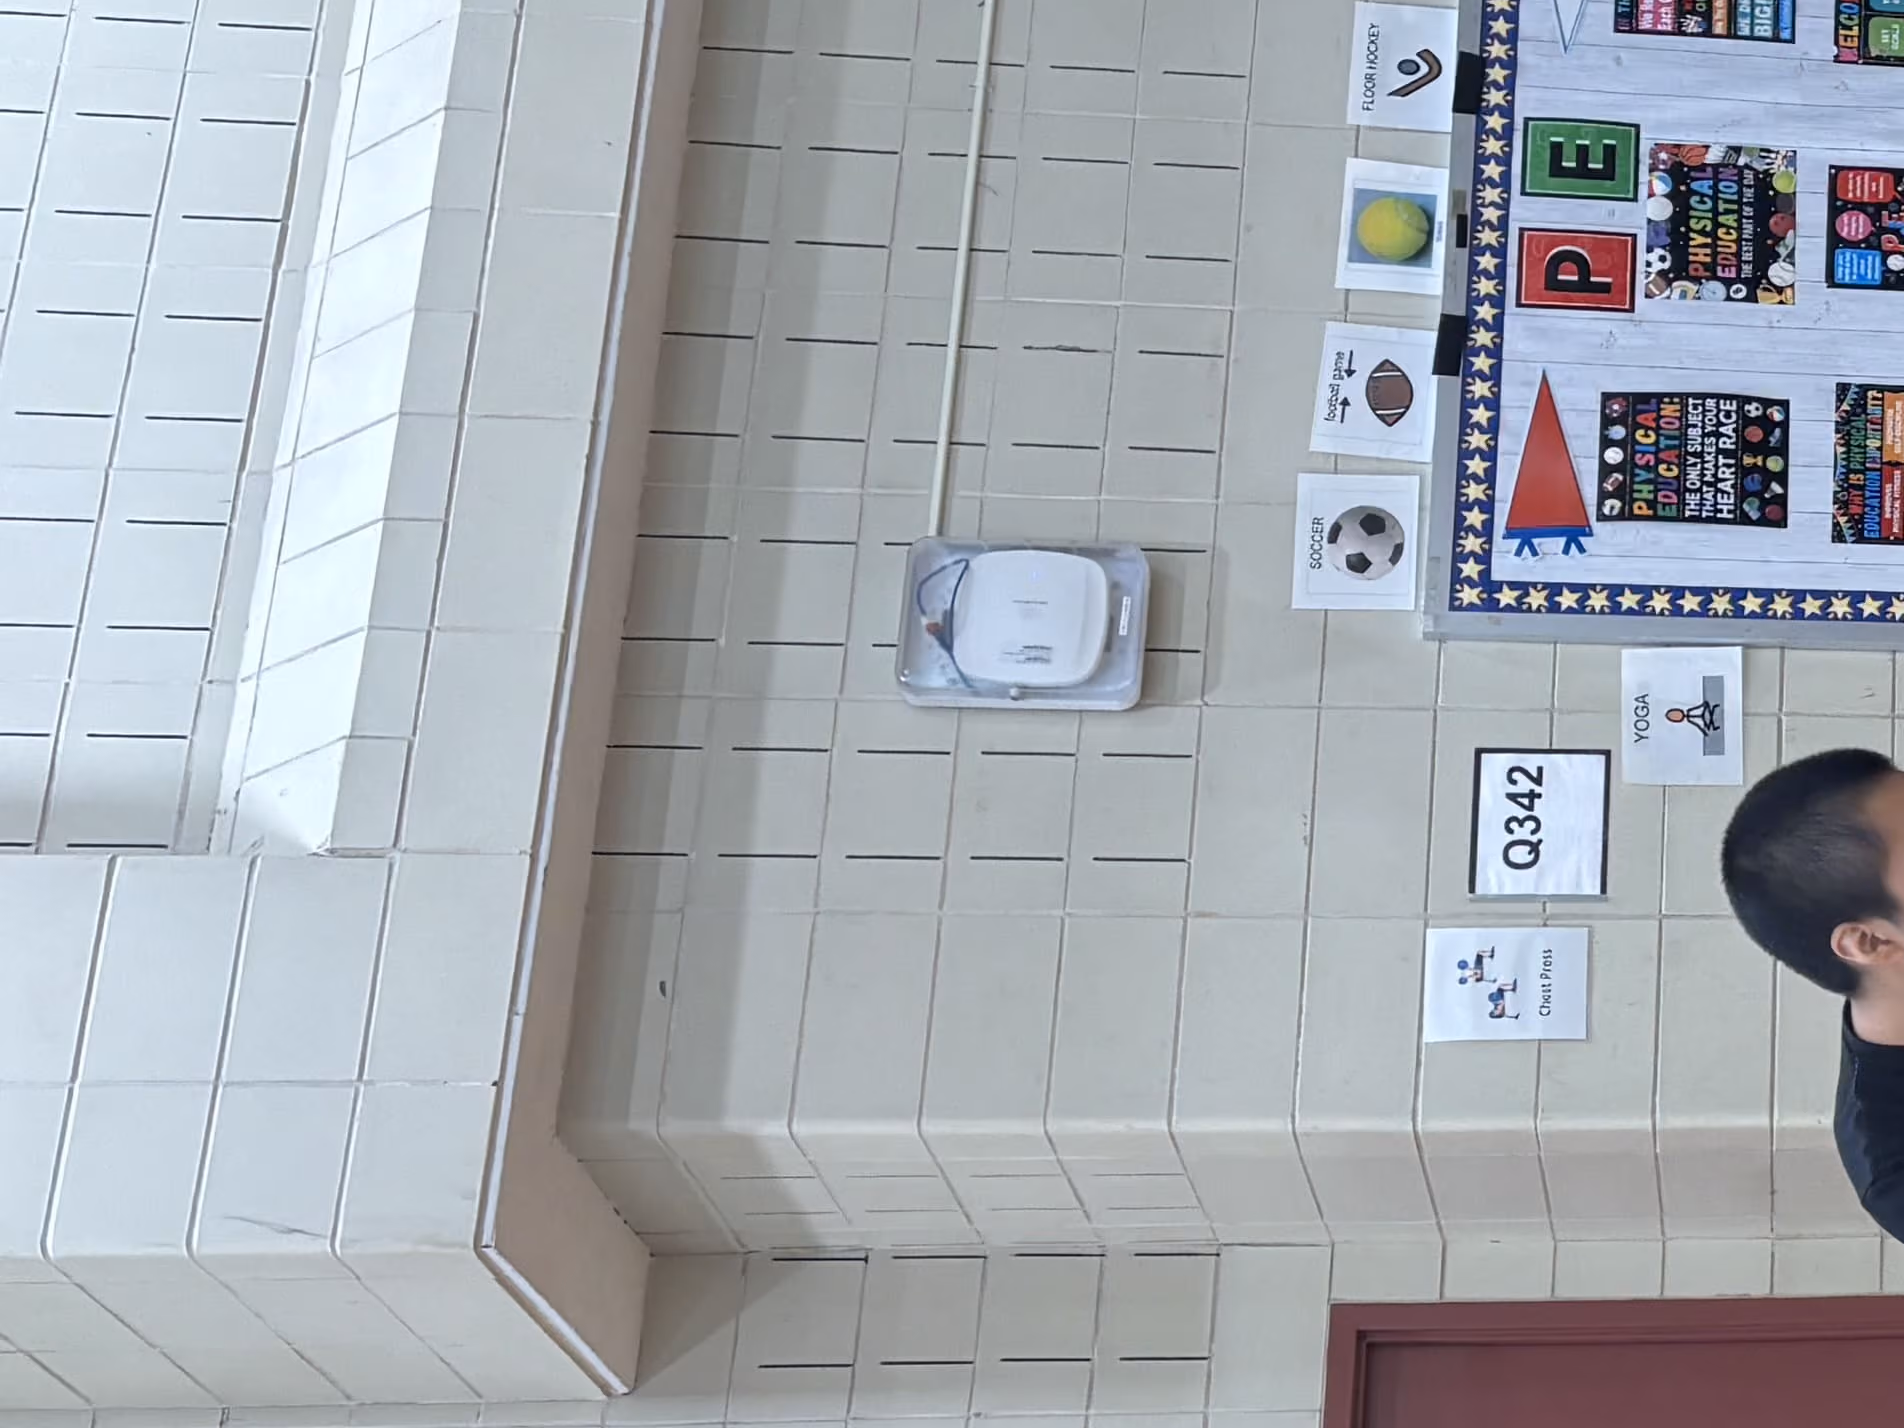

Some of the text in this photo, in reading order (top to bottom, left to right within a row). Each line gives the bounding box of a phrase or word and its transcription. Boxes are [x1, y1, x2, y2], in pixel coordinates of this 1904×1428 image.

[1362, 23, 1380, 111] FLOOR HOCKEY
[1638, 12, 1654, 30] We
[1658, 6, 1672, 30] Each
[1544, 136, 1616, 294] P E
[1688, 167, 1715, 277] PHYSICAL
[1716, 166, 1739, 278] EDUCATION
[1740, 168, 1754, 278] THE BEST PART OF THE DAY
[1324, 351, 1344, 422] football game
[1632, 398, 1657, 516] PHYSICAL
[1657, 397, 1681, 517] EDUCATION:
[1685, 398, 1703, 517] THE ONLY SUBJECT
[1702, 398, 1718, 518] THAT MAKES YOUR
[1717, 399, 1737, 518] HEART RACE
[1848, 414, 1866, 514] WHY IS PHYSICAL
[1865, 390, 1882, 538] EDUCATION IMPORTANT?
[1310, 517, 1324, 570] SOCCER
[1634, 694, 1650, 743] YOGA
[1502, 765, 1544, 870] Q342
[1538, 948, 1553, 1016] Chest Press
